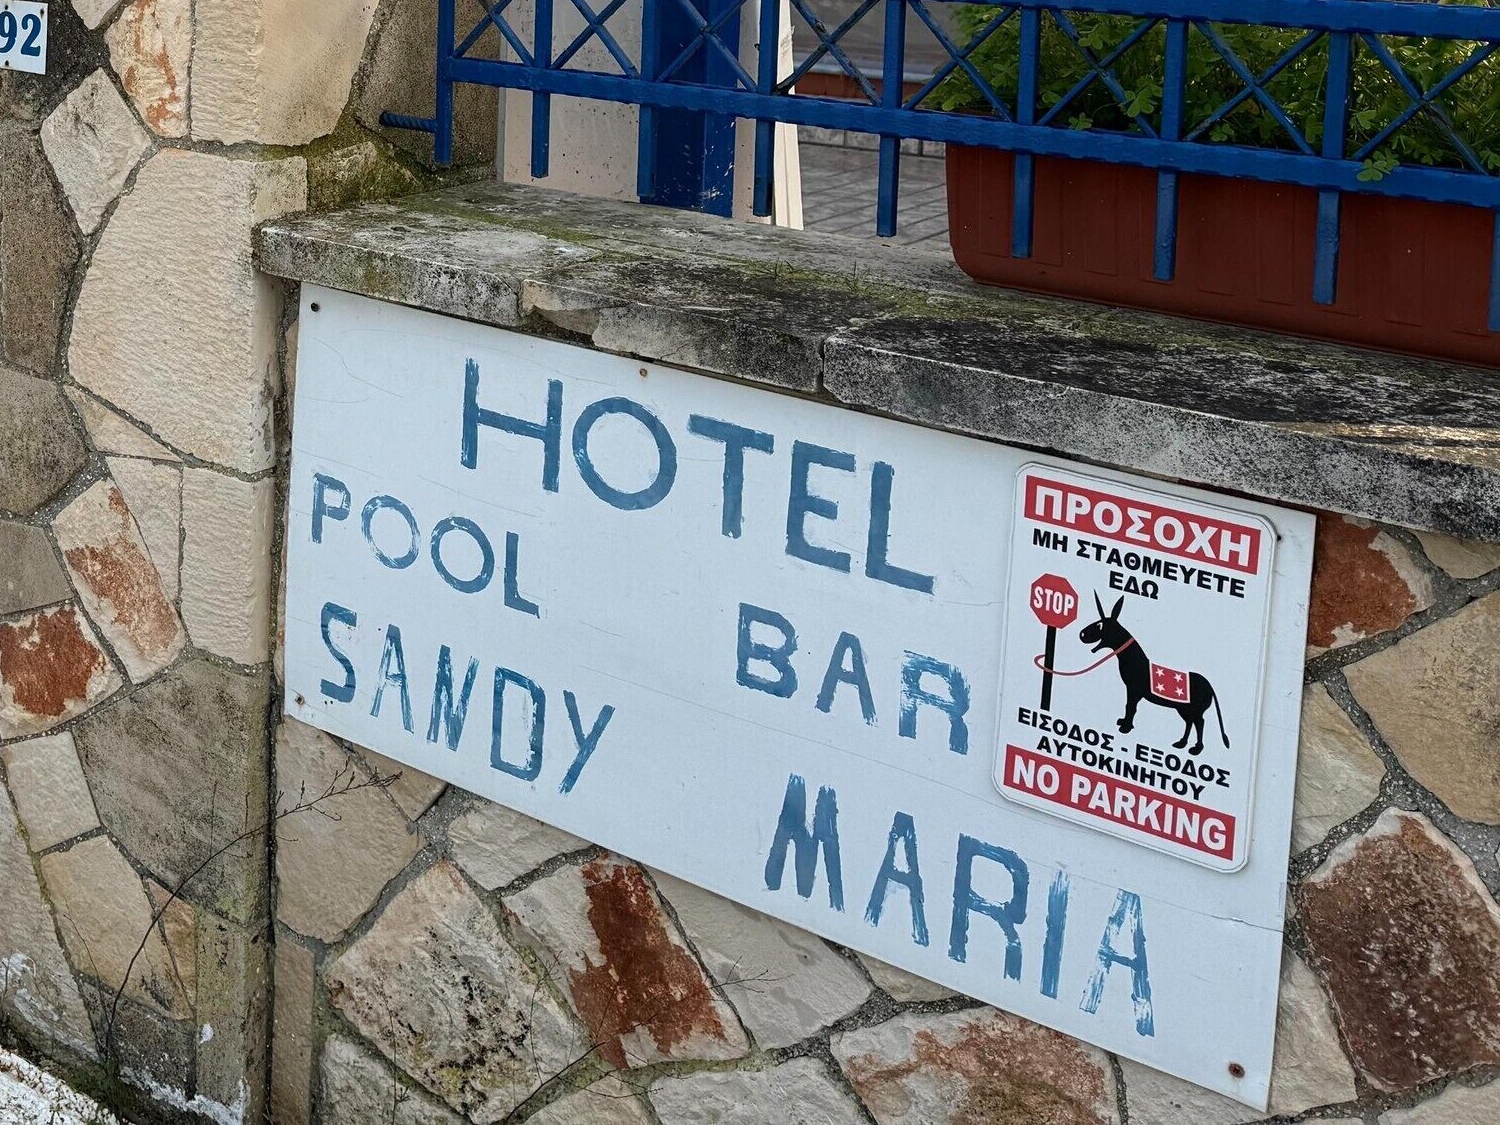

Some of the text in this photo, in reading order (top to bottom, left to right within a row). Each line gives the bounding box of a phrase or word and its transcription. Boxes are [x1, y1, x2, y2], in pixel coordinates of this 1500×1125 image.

[460, 358, 935, 594] HOTEL
[1032, 527, 1247, 599] ΜΗ ΣΤΑΘΜΕΥΕΤΕ
[1034, 484, 1252, 568] ΠΡΟΣΟΧΗ
[311, 472, 970, 755] POOL BAR
[1033, 586, 1075, 617] STOP
[1108, 570, 1160, 600] ΕΔΩ
[1017, 706, 1115, 753] ΕΙΣΟΔΟΣ
[1135, 742, 1231, 788] ΕΞΟΔΟΣ
[1036, 735, 1206, 801] ΑΥΤΟΚΙΝΗΤΟΥ
[319, 601, 1156, 1038] SANDY MARIA
[1012, 753, 1228, 852] NO PARKING
